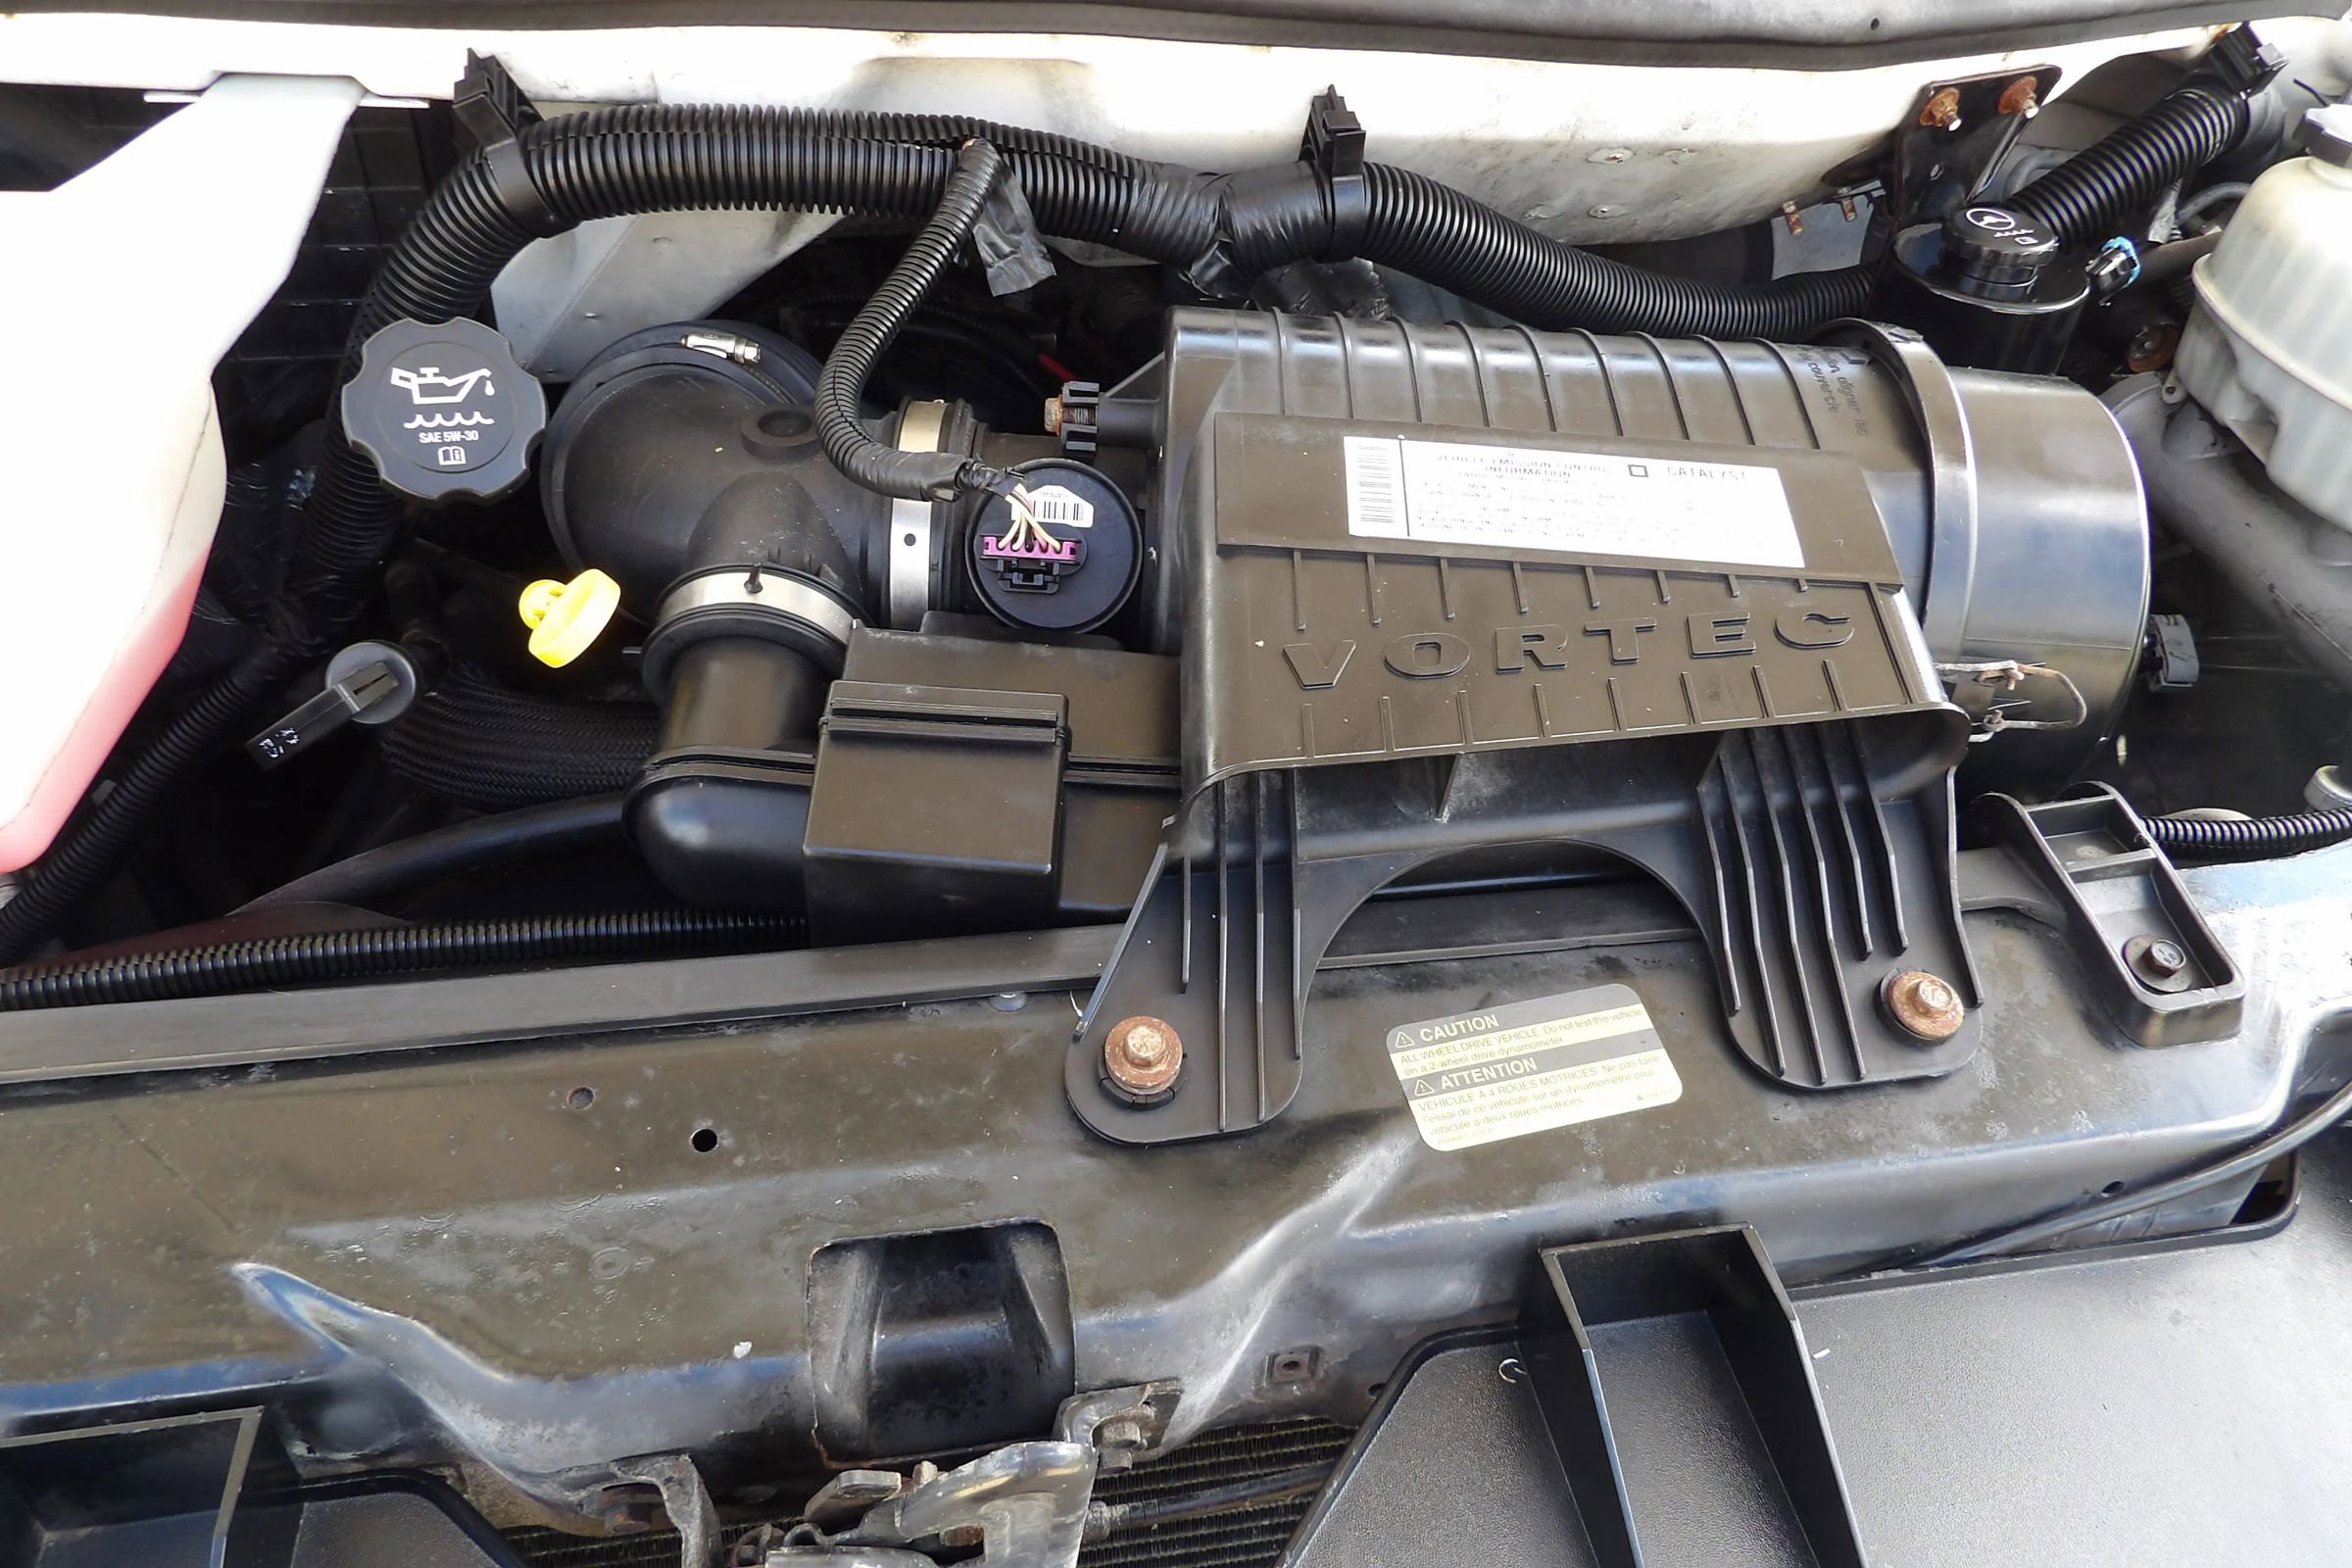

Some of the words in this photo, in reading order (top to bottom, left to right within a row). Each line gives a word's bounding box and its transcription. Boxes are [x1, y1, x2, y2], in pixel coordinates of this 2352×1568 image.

[418, 431, 442, 444] SAE
[443, 429, 479, 443] 5W-30
[1667, 465, 1747, 481] CATALYST
[1282, 611, 1855, 690] VORTEC
[1400, 1054, 1420, 1065] ALL
[1420, 1045, 1460, 1060] WHEEL
[1460, 1037, 1495, 1053] DRIVE
[1543, 1024, 1558, 1035] Do
[1559, 1021, 1574, 1032] not
[1575, 1017, 1592, 1029] test
[1592, 1014, 1610, 1025] this
[1611, 1008, 1642, 1021] vehicle
[1419, 1013, 1499, 1042] CAUTION
[1404, 1065, 1418, 1076] on
[1420, 1064, 1428, 1074] a
[1430, 1056, 1469, 1070] 2-wheel
[1471, 1049, 1496, 1061] drive
[1441, 1056, 1538, 1090] ATTENTION
[1489, 1088, 1496, 1097] 4
[1497, 1078, 1539, 1095] ROUES
[1601, 1062, 1617, 1074] Ne
[1619, 1059, 1638, 1072] pas
[1638, 1054, 1660, 1067] faire
[1457, 1105, 1472, 1117] de
[1473, 1103, 1487, 1113] ce
[1532, 1091, 1547, 1102] sur
[1549, 1089, 1563, 1098] un
[1634, 1068, 1654, 1082] pour
[1483, 1111, 1508, 1125] deux
[1509, 1105, 1539, 1119] roues
